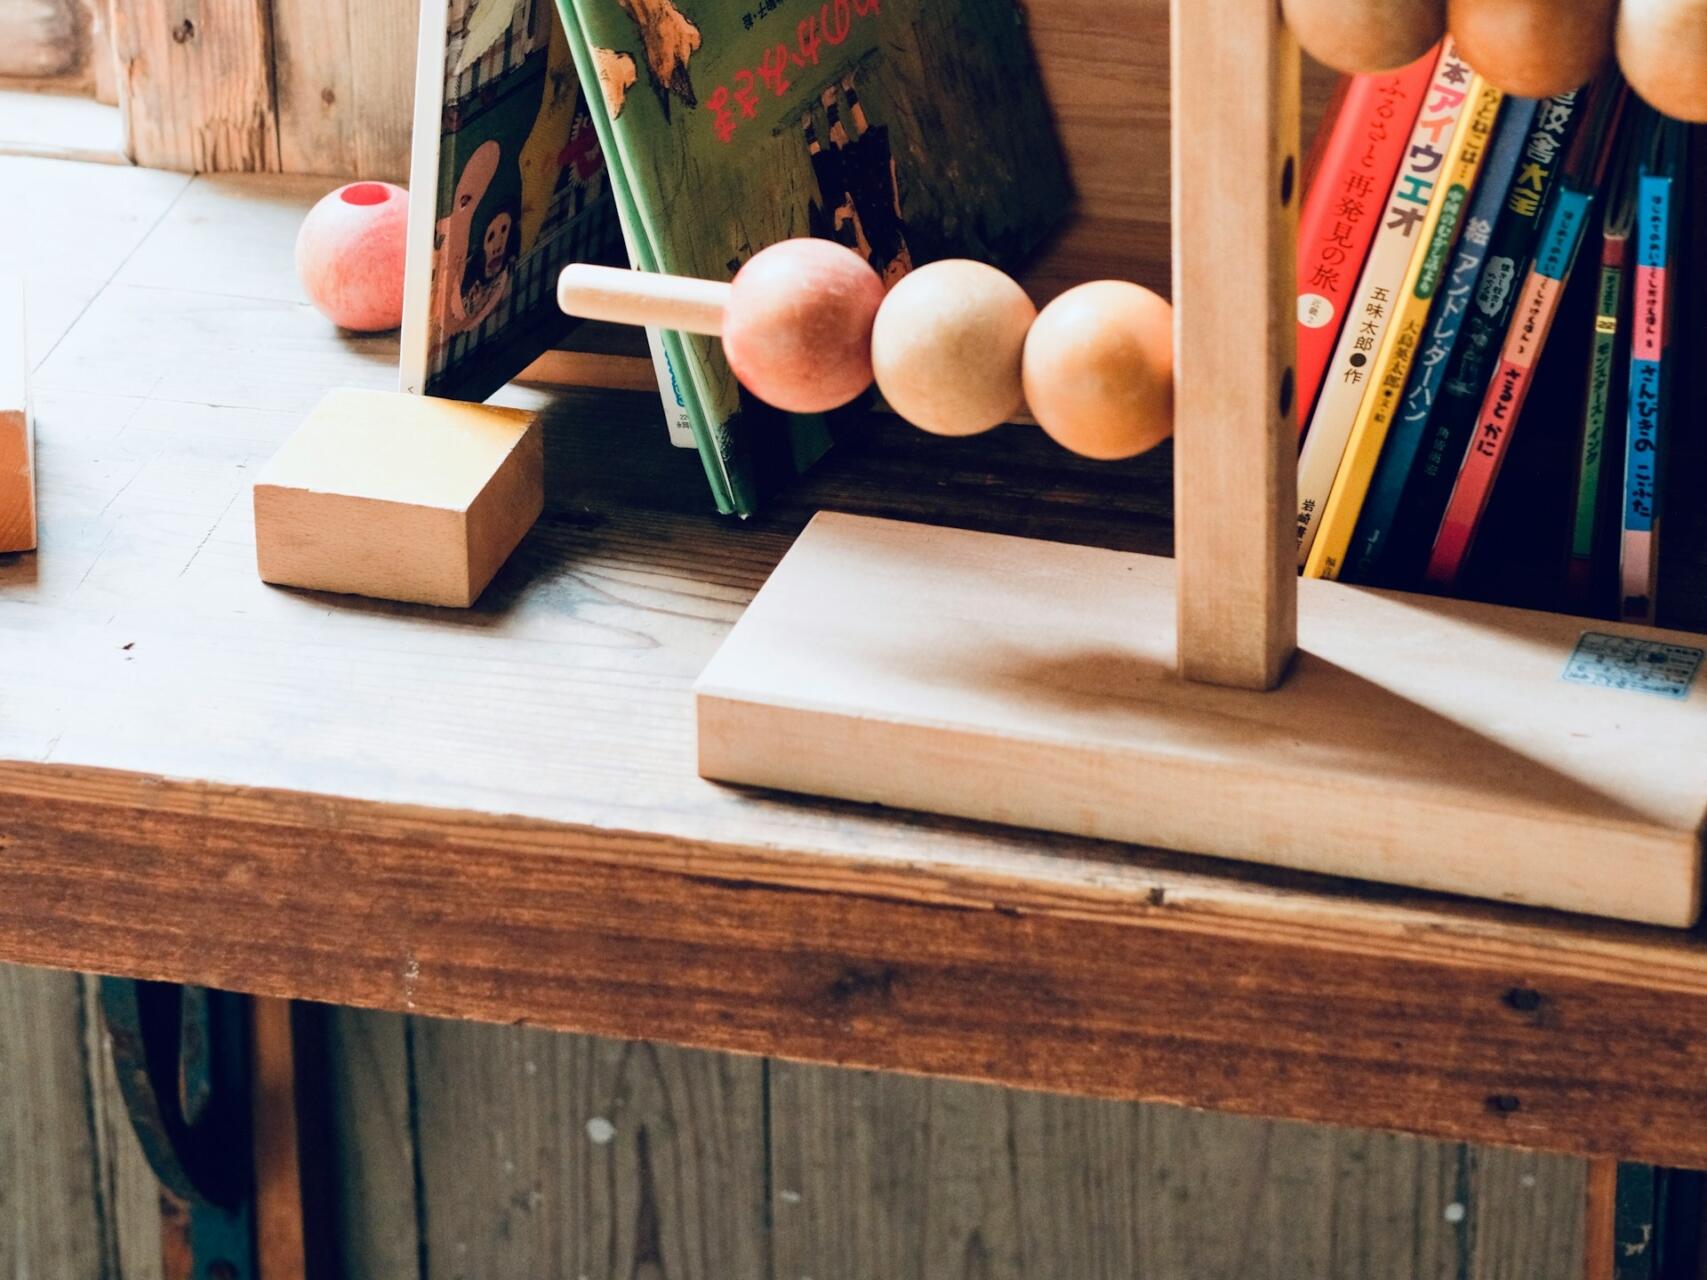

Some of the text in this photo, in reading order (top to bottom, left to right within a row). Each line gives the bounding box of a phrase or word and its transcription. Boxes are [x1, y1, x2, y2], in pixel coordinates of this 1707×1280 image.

[1387, 45, 1470, 238] 本アイウエオ
[1404, 216, 1491, 421] 絵 アンドレ・ダーハン
